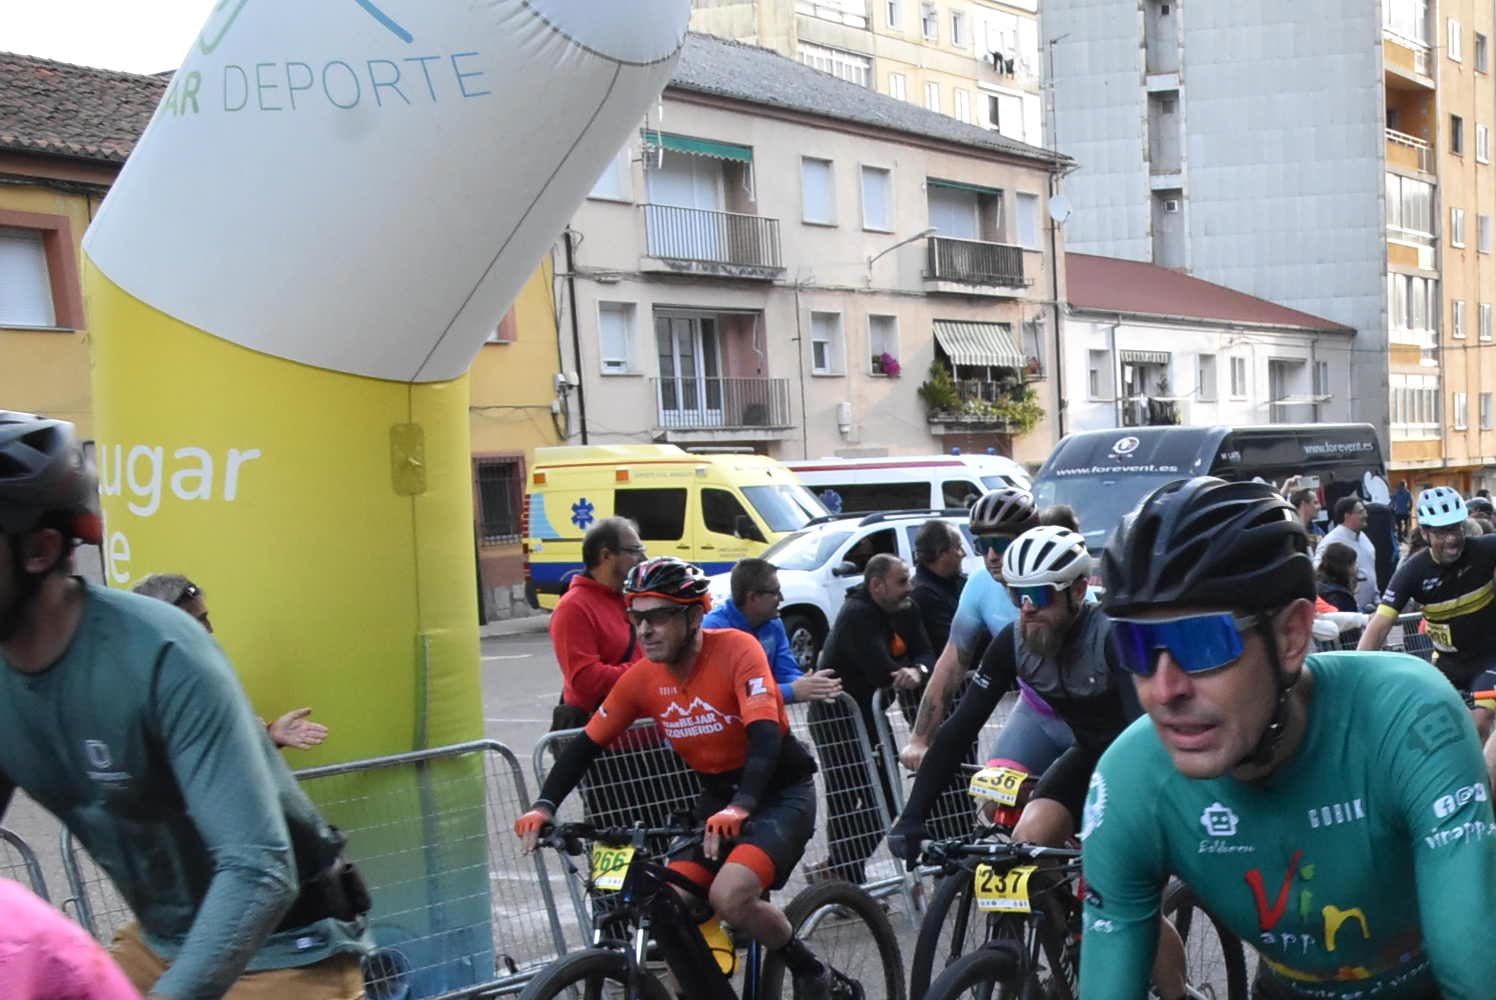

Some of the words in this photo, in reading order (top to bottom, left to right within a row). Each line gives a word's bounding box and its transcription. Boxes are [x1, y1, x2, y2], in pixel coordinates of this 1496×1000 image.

[223, 51, 492, 113] DEPORTE
[1303, 441, 1375, 455] www.forevent.es
[100, 443, 262, 517] ugar
[1056, 464, 1178, 477] www.forevent.es
[980, 870, 1024, 894] 237
